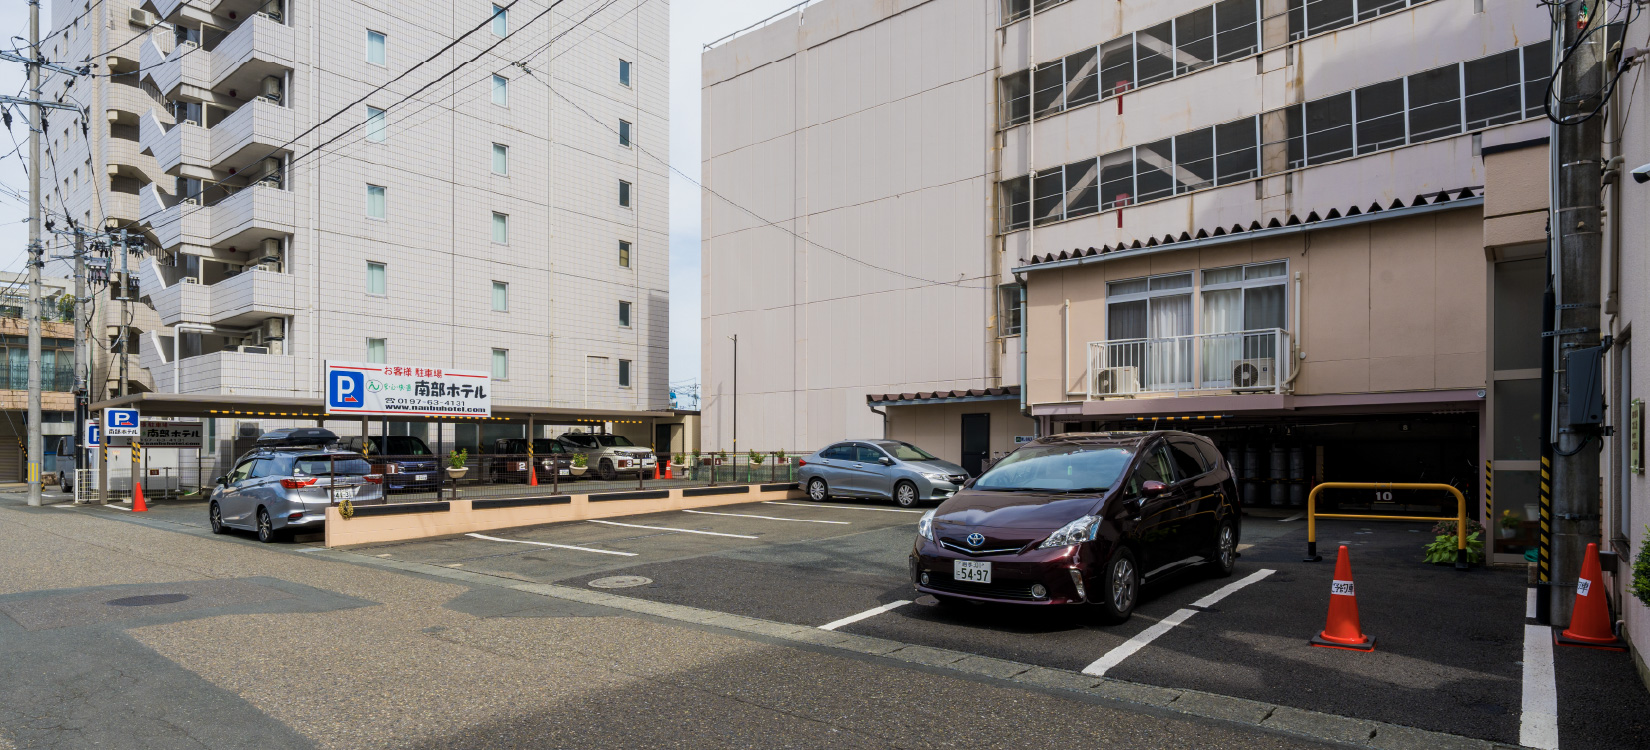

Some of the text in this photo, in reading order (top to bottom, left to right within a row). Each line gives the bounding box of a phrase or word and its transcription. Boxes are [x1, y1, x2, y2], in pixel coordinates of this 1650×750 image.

[384, 366, 443, 379] お客様 駐車場
[337, 375, 355, 403] P
[414, 380, 487, 399] 南部ホテル
[397, 398, 465, 407] 0197-63-4131
[385, 403, 486, 413] www.nanbuhotel.com
[114, 412, 130, 426] P
[147, 428, 200, 437] 南部ホテル
[390, 464, 395, 474] 1
[518, 461, 526, 470] 2
[1375, 491, 1393, 501] 10
[961, 568, 988, 581] 54-97
